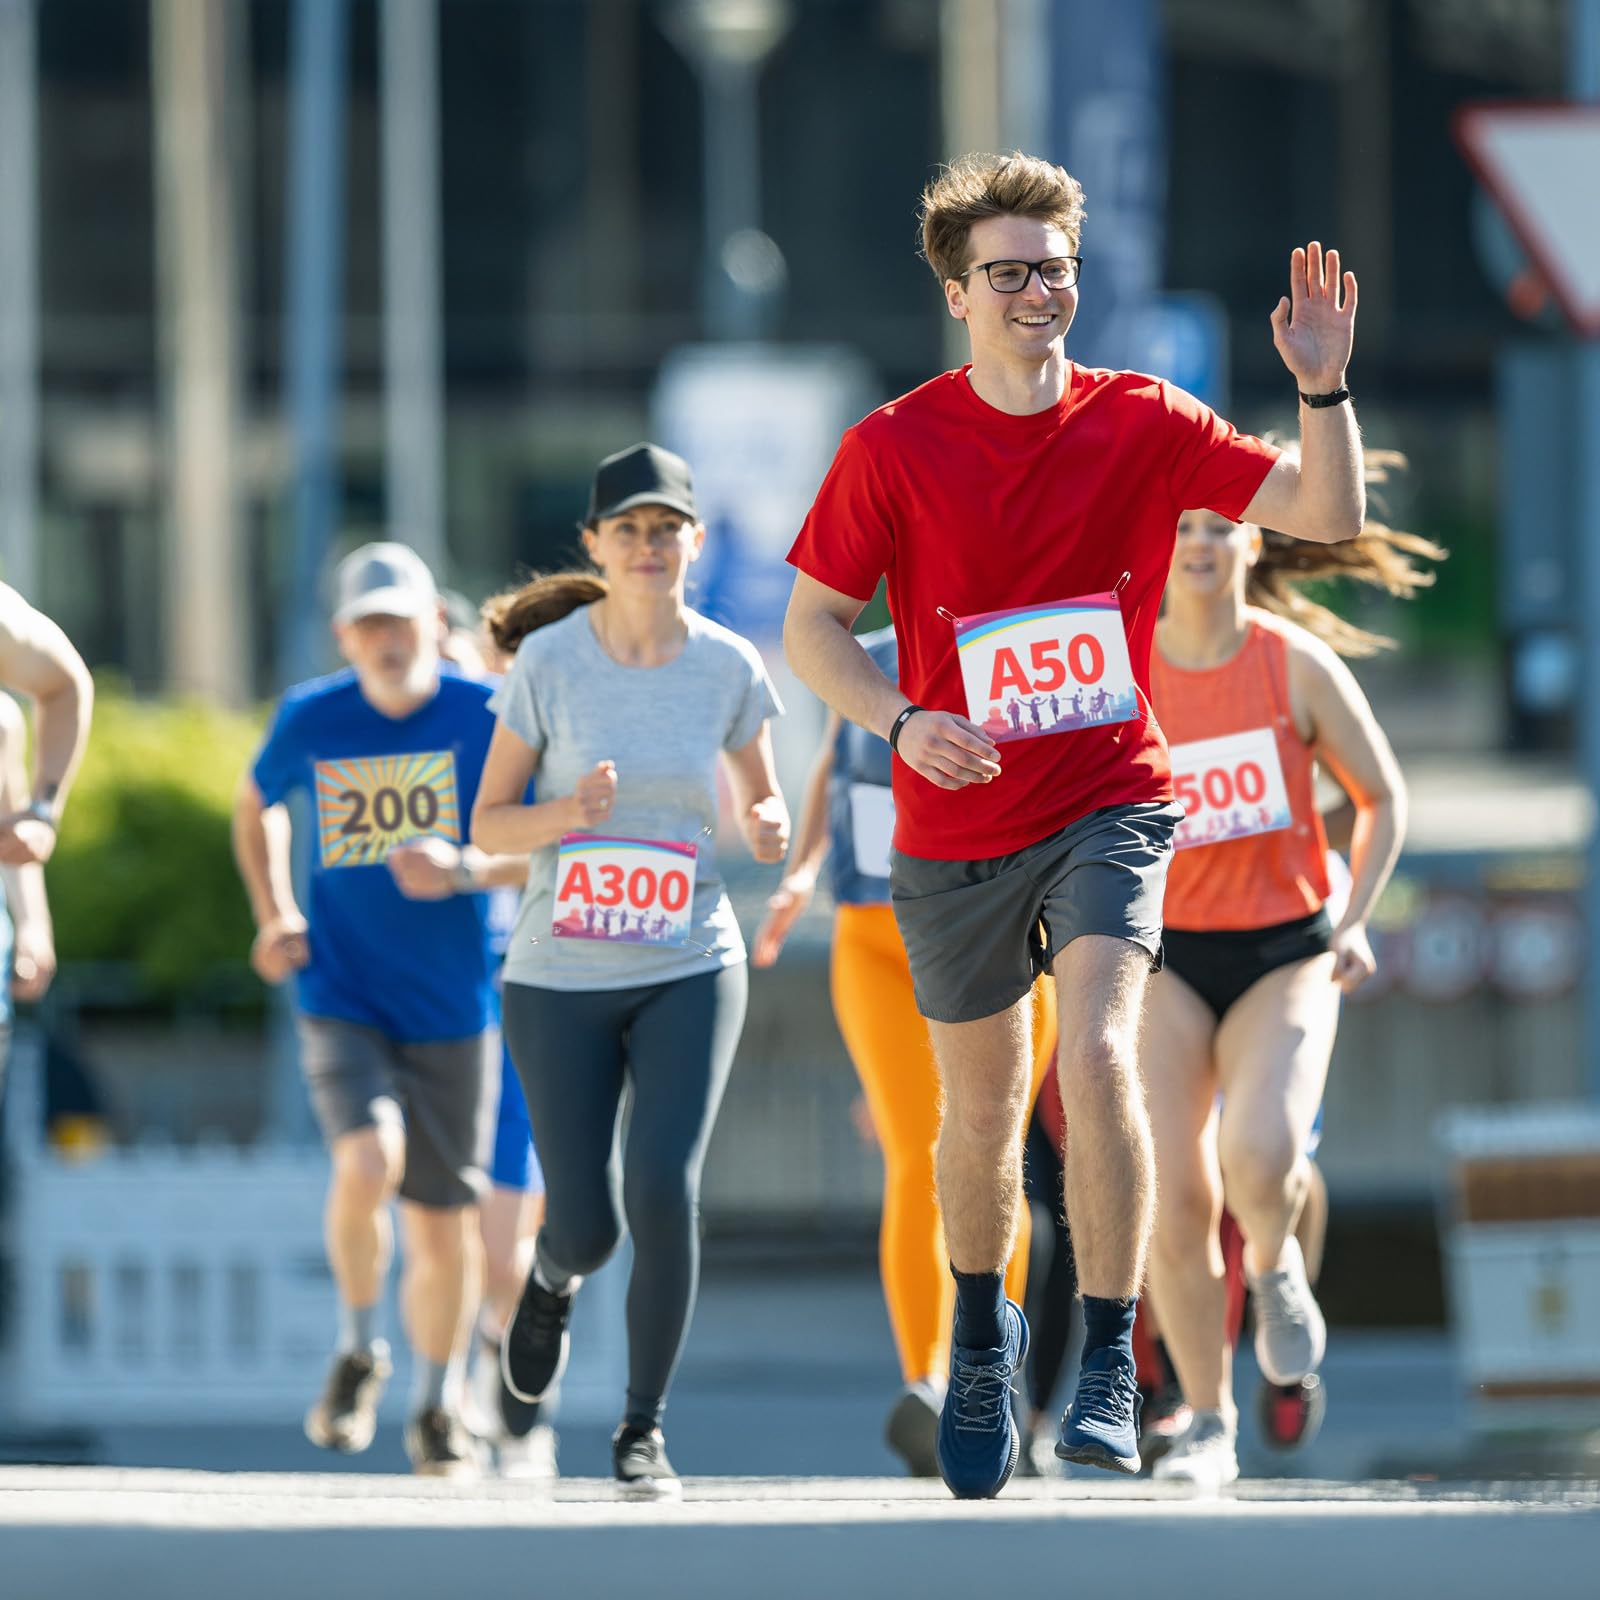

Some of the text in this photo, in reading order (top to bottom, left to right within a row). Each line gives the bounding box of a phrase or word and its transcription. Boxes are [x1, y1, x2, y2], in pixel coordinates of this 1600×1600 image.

[989, 633, 1105, 701] A50
[340, 785, 438, 834] 200
[558, 861, 689, 912] A300
